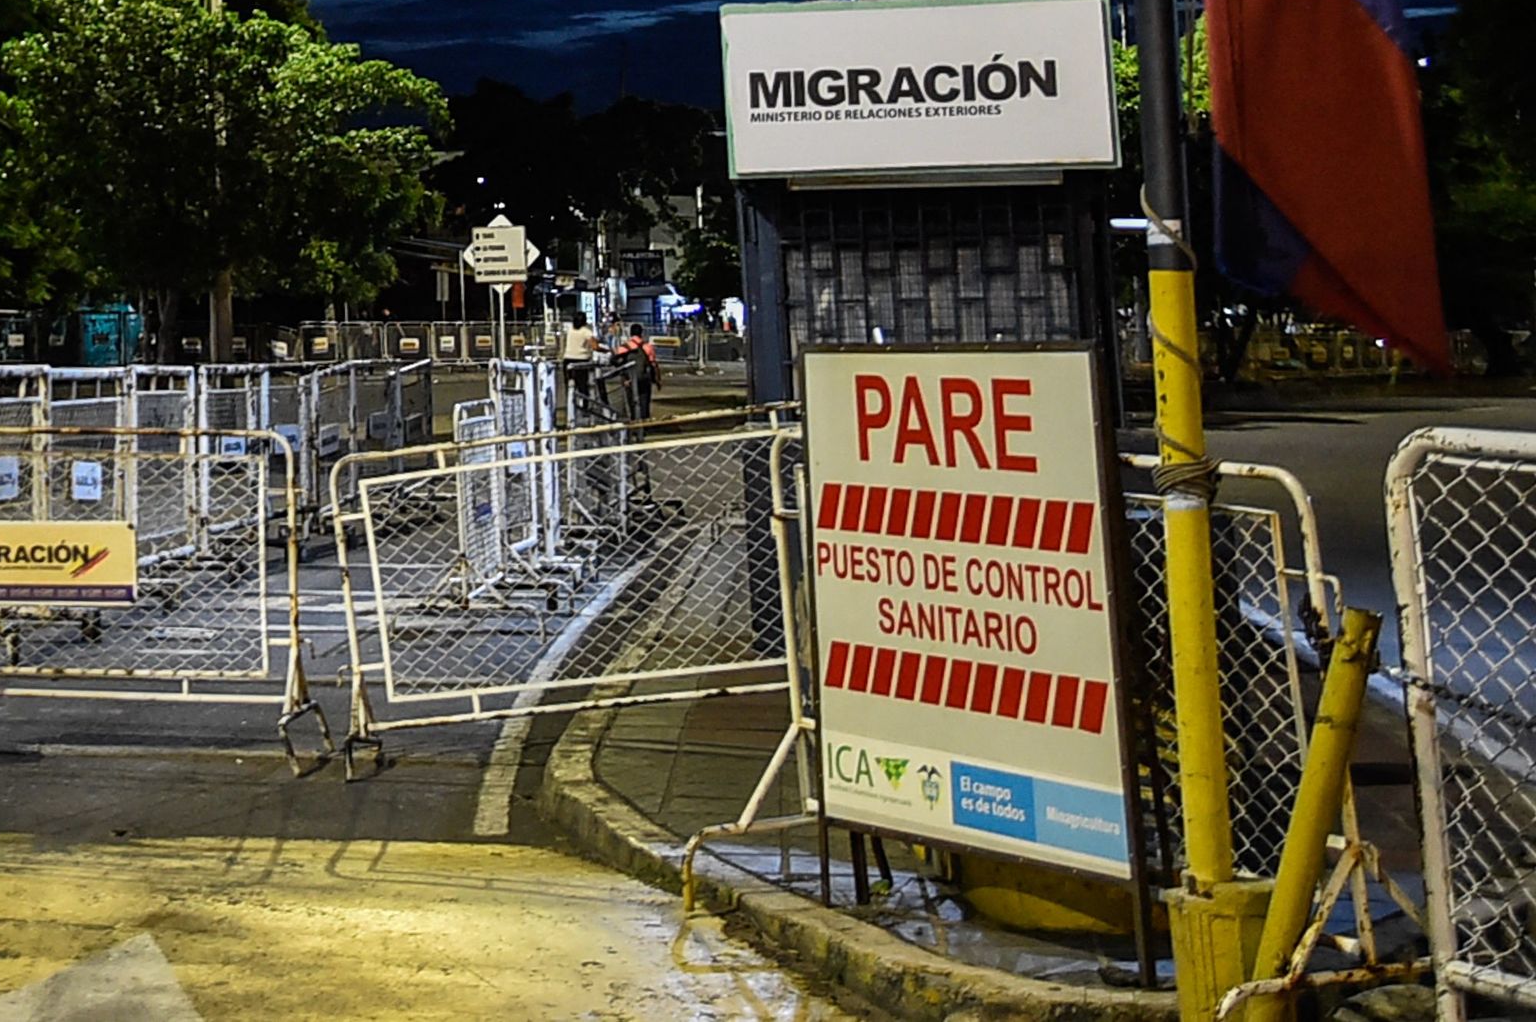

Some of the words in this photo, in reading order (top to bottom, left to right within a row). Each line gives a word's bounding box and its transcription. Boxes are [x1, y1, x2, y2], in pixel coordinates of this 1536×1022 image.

[749, 53, 1058, 108] MIGRACIÓN
[750, 110, 822, 123] MINISTERIO
[825, 109, 841, 121] DE
[844, 107, 922, 120] RELACIONES
[925, 105, 1001, 118] EXTERIORES
[855, 374, 1038, 473] PARE
[817, 542, 915, 587] PUESTO
[923, 553, 958, 592] DE
[966, 558, 1103, 611] CONTROL
[878, 598, 1037, 655] SANITARIO
[827, 742, 874, 787] ICA
[960, 776, 971, 792] El
[972, 781, 1012, 802] campo
[961, 797, 974, 811] es
[975, 797, 990, 814] de
[992, 801, 1026, 822] todos
